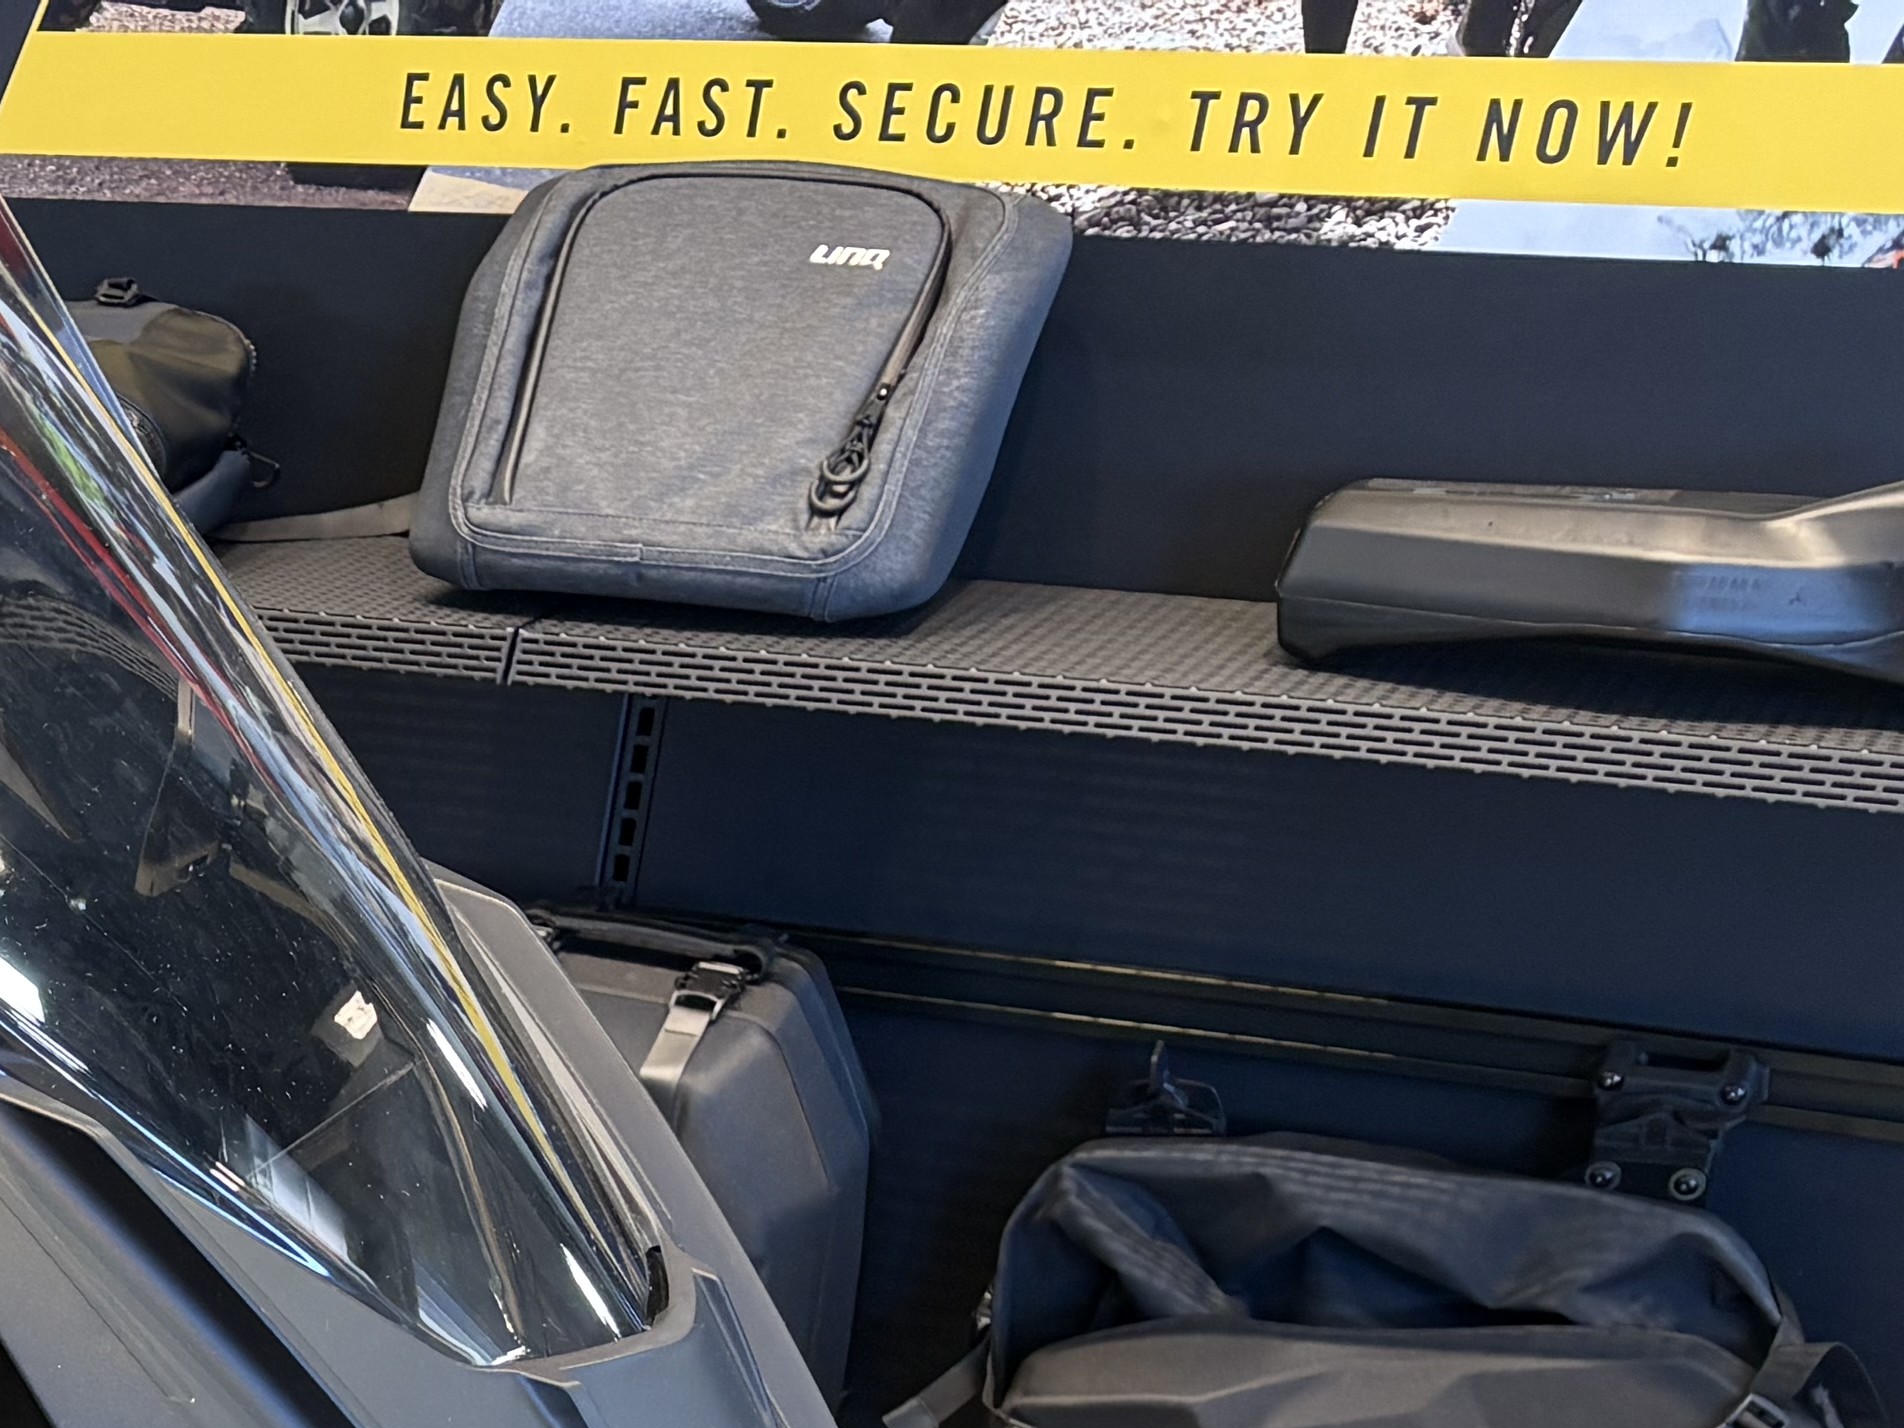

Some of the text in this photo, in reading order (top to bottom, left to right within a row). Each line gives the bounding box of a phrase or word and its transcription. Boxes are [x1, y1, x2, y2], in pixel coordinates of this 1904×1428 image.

[399, 71, 1694, 168] EASY. FAST. SECURE. TRY IT NOW!
